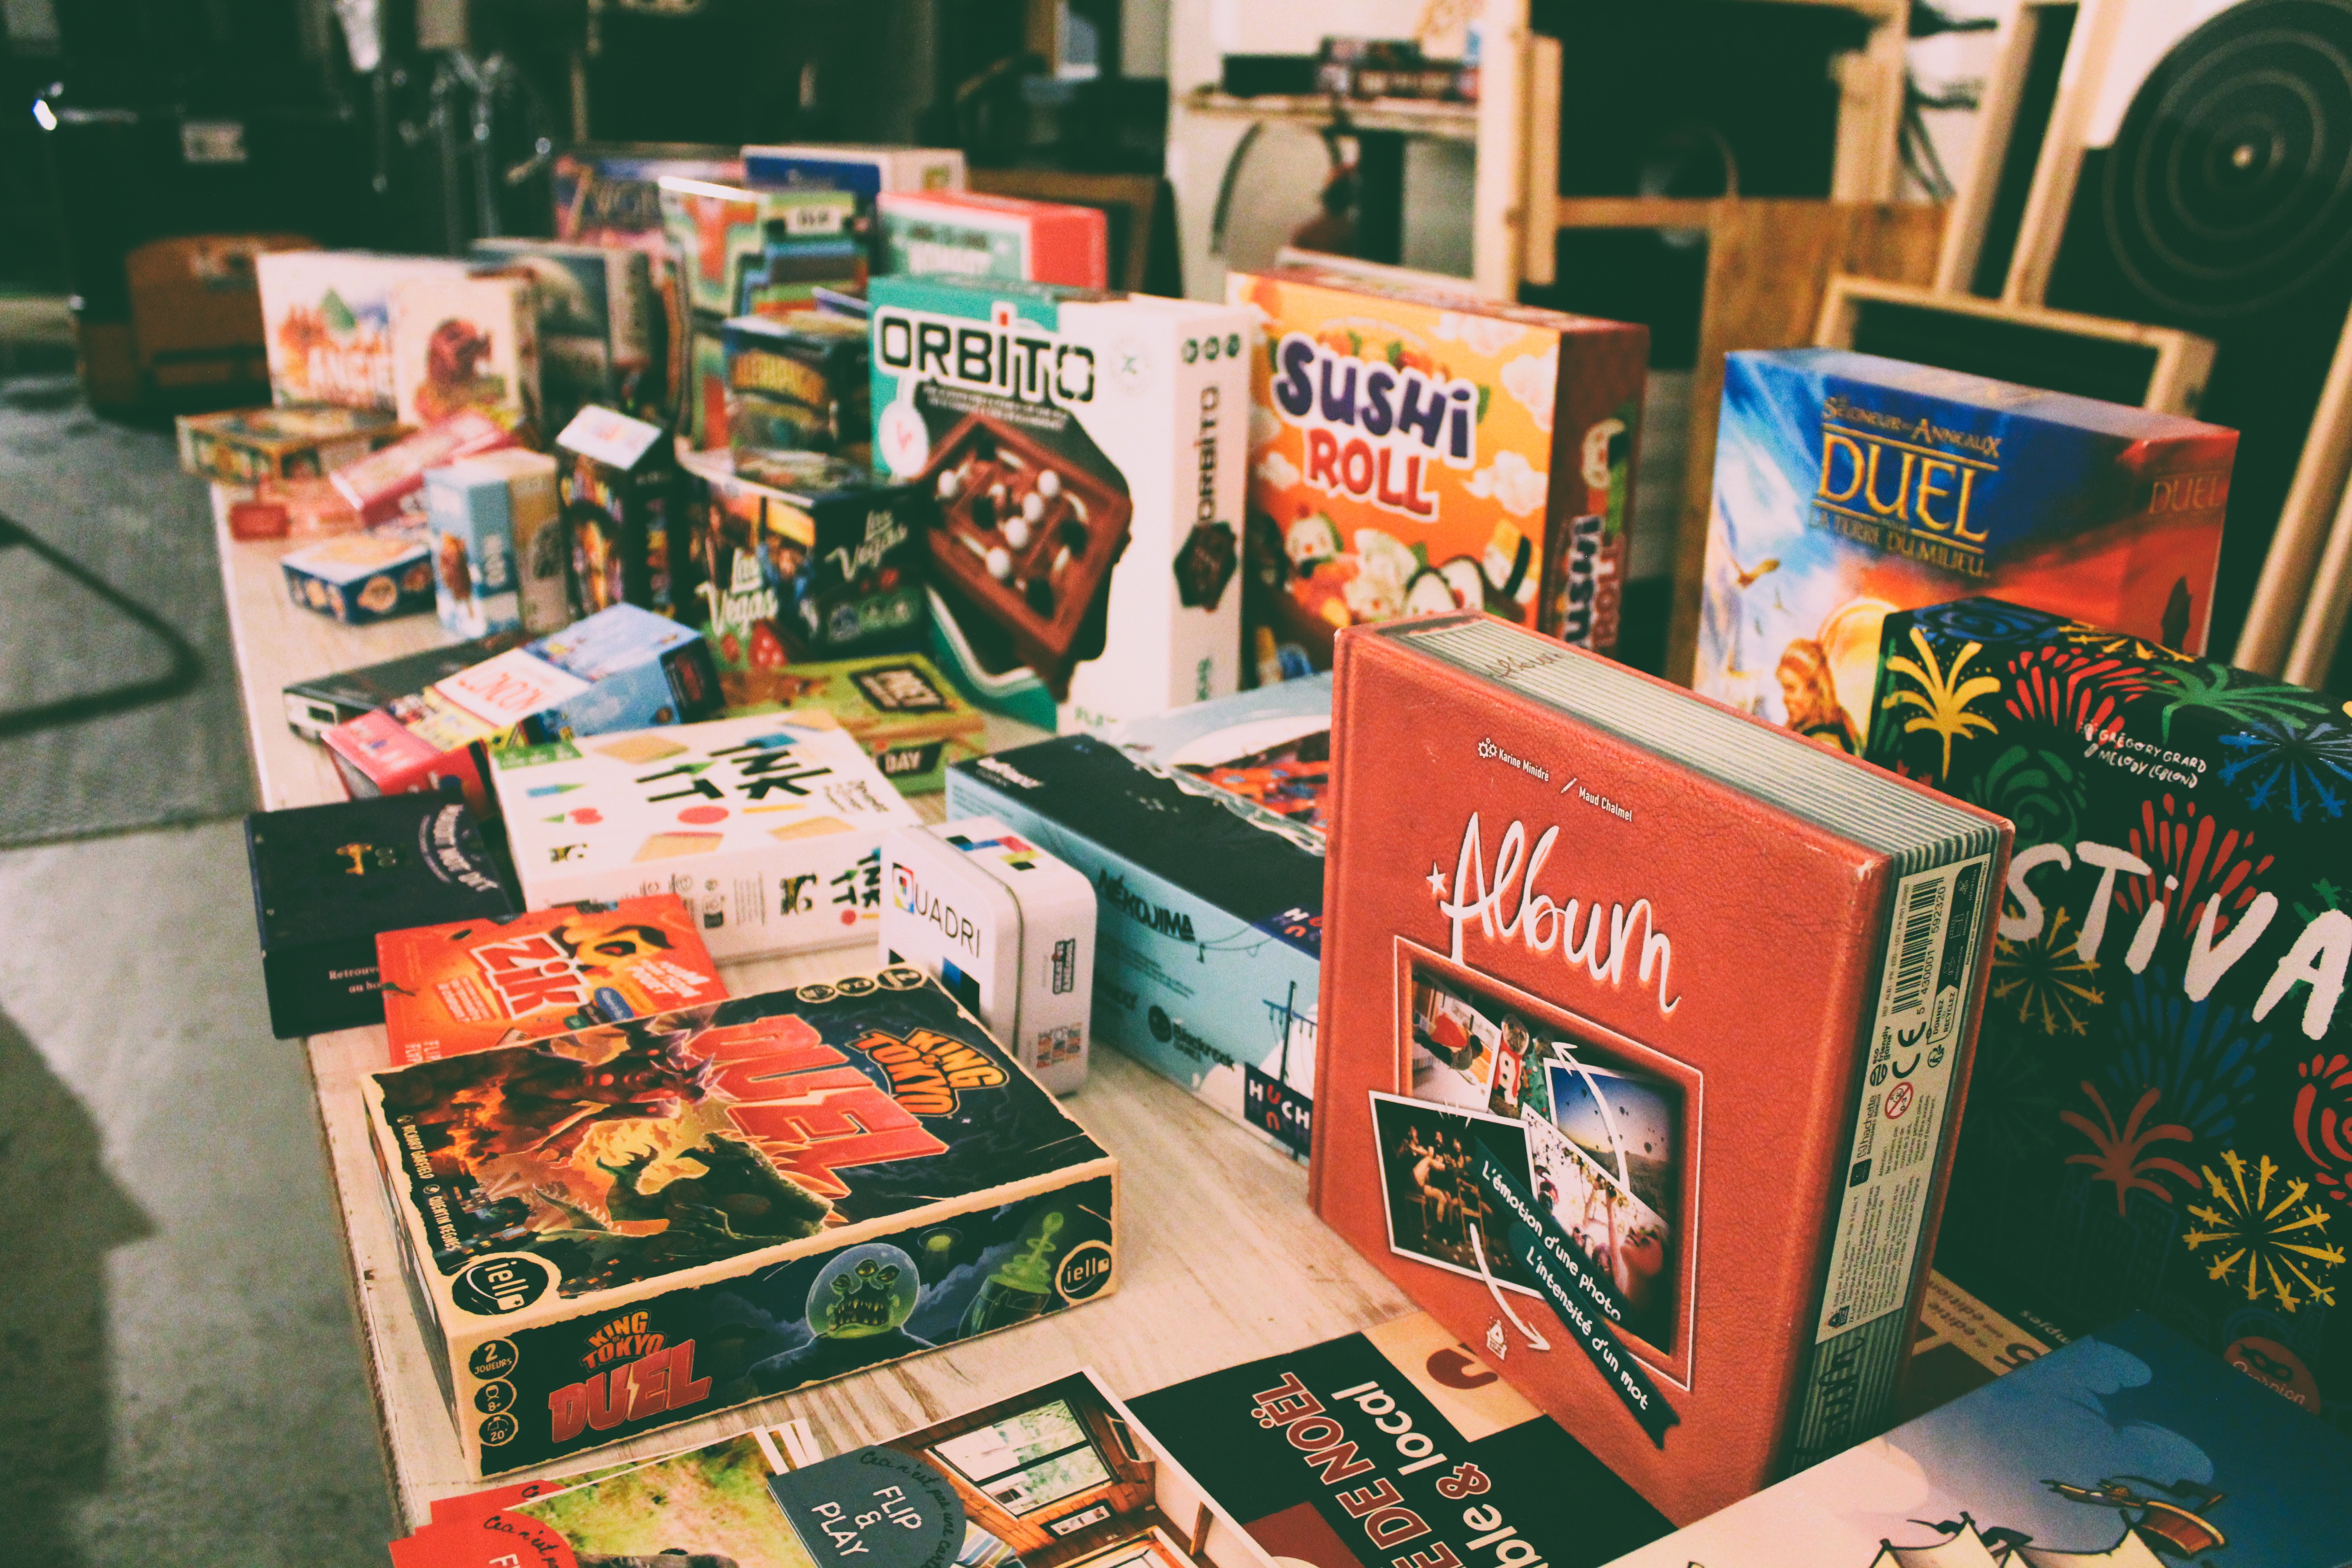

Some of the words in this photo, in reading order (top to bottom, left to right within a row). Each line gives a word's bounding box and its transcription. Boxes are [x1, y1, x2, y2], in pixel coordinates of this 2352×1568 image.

[880, 310, 1095, 403] ORBITO
[1307, 428, 1433, 516] ROLL
[1817, 431, 1989, 543] DUEL
[2148, 474, 2222, 514] DUEL
[885, 750, 922, 774] DAY
[1498, 748, 1522, 769] Karine
[1522, 760, 1550, 782] Minidré
[2162, 750, 2207, 773] GRARD
[1578, 786, 1600, 807] Maud
[1600, 796, 1633, 823] Chalmel
[892, 861, 981, 959] QUADRI
[1439, 811, 1682, 1014] Album
[1930, 885, 1947, 934] 592320
[1919, 949, 1936, 996] 430001
[1916, 1007, 1925, 1015] 5
[1932, 999, 1944, 1035] DONNEZ
[1942, 991, 1955, 1033] RECYCLEZ
[906, 1029, 1004, 1090] KING
[1877, 1024, 1891, 1063] friendly
[1883, 1033, 1894, 1061] game
[853, 1031, 954, 1115] TOKYO
[401, 1124, 424, 1151] RICHARD
[1859, 1093, 1877, 1145] hachette
[411, 1150, 435, 1180] GARFIELD
[427, 1195, 447, 1224] QUENTIN
[1481, 1160, 1544, 1239] L'émotion
[1544, 1236, 1578, 1277] d'une
[1579, 1273, 1622, 1322] photo
[588, 1310, 650, 1347] KING
[1525, 1245, 1592, 1336] L'intensité
[1592, 1337, 1619, 1372] d'un
[1620, 1369, 1649, 1411] mot
[473, 1357, 513, 1376] JOUEURS
[484, 1343, 499, 1362] 2
[581, 1333, 666, 1370] TOKYO
[548, 1338, 712, 1443] DUEL
[1250, 1371, 1377, 1486] NOËL
[1330, 1380, 1448, 1476] local
[854, 1510, 882, 1530] &
[872, 1485, 923, 1529] FLIP
[1335, 1477, 1433, 1551] DE
[810, 1501, 870, 1557] PLAY
